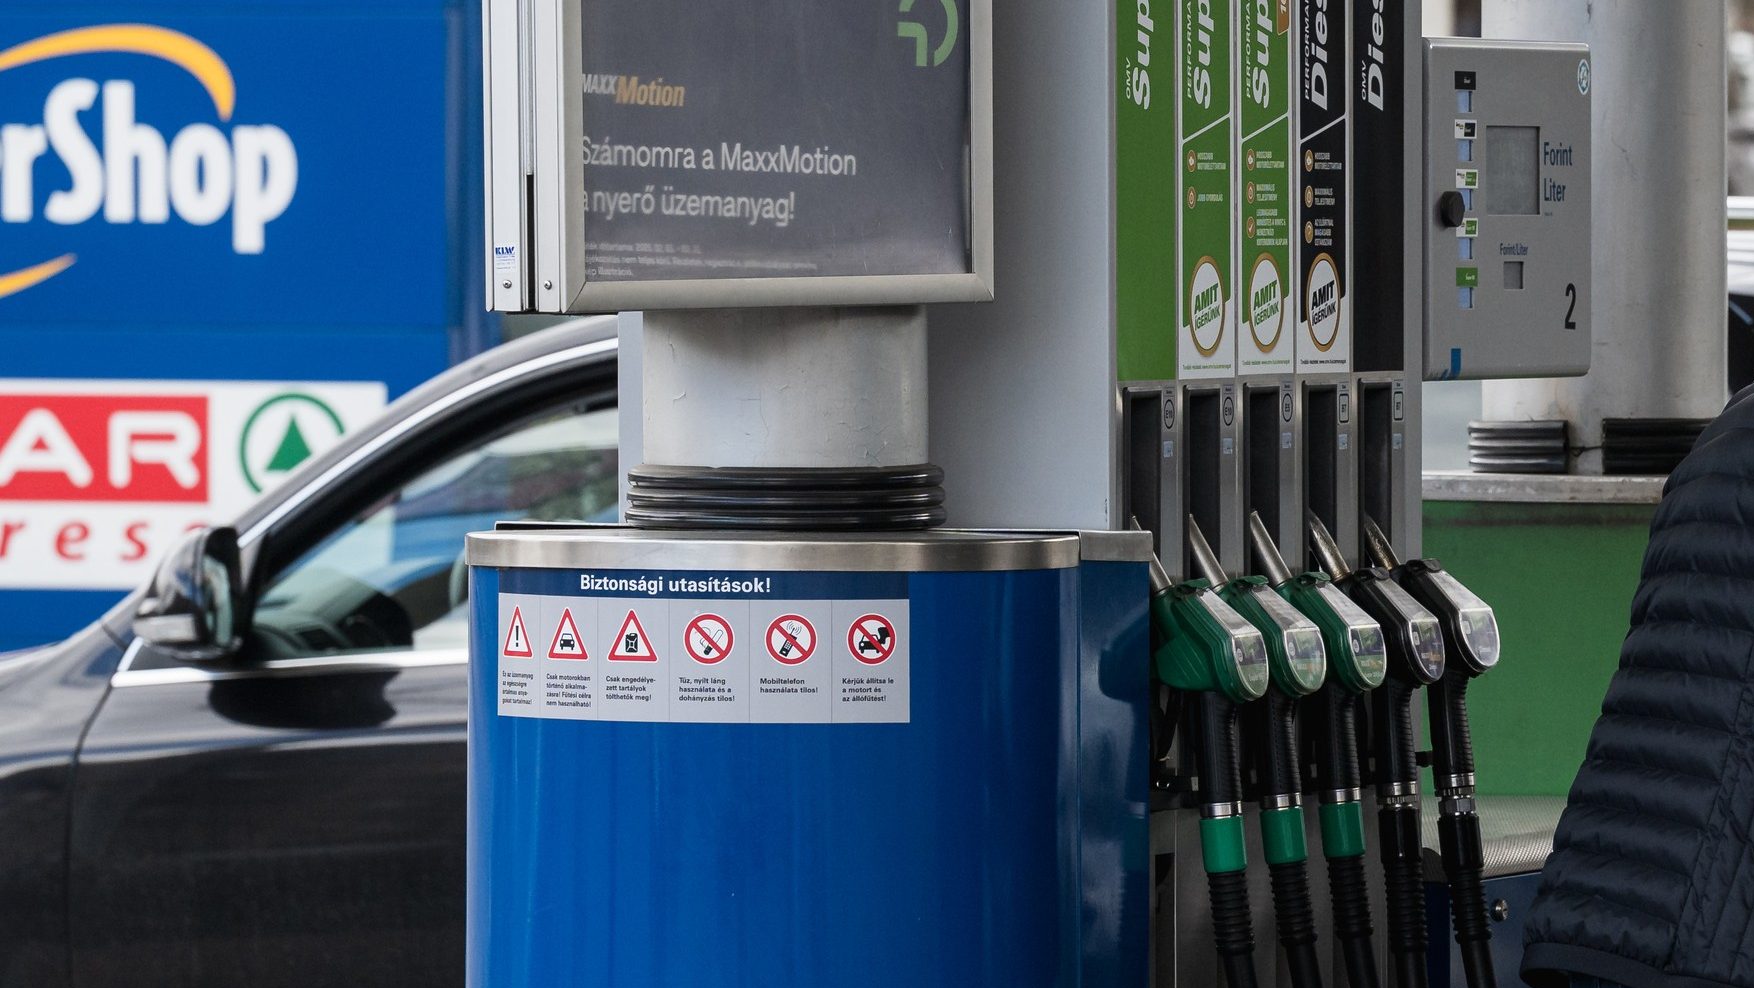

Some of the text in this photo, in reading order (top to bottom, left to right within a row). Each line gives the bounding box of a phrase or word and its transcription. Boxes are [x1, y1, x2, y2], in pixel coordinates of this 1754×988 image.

[1132, 0, 1154, 110] Sup
[1193, 0, 1214, 109] Sup
[1252, 0, 1273, 109] Sup
[582, 136, 856, 175] Számomra a MaxxMotion
[1543, 141, 1573, 166] Forint
[1543, 177, 1566, 202] Liter
[593, 185, 655, 220] nyerő
[661, 185, 794, 227] üzemanyag!
[1500, 243, 1529, 256] Forint/Liter
[1194, 282, 1219, 315] AMIT
[1253, 279, 1277, 311] AMIT
[1310, 280, 1335, 311] AMIT
[1564, 282, 1577, 330] 2
[0, 407, 202, 490] AR
[0, 520, 212, 562] res
[580, 574, 771, 595] Biztonsági utasítások!
[621, 676, 656, 684] engedélye-
[710, 677, 726, 685] láng
[842, 678, 864, 686] Kérjük
[635, 694, 652, 702] meg!
[679, 695, 716, 703] dohányzás
